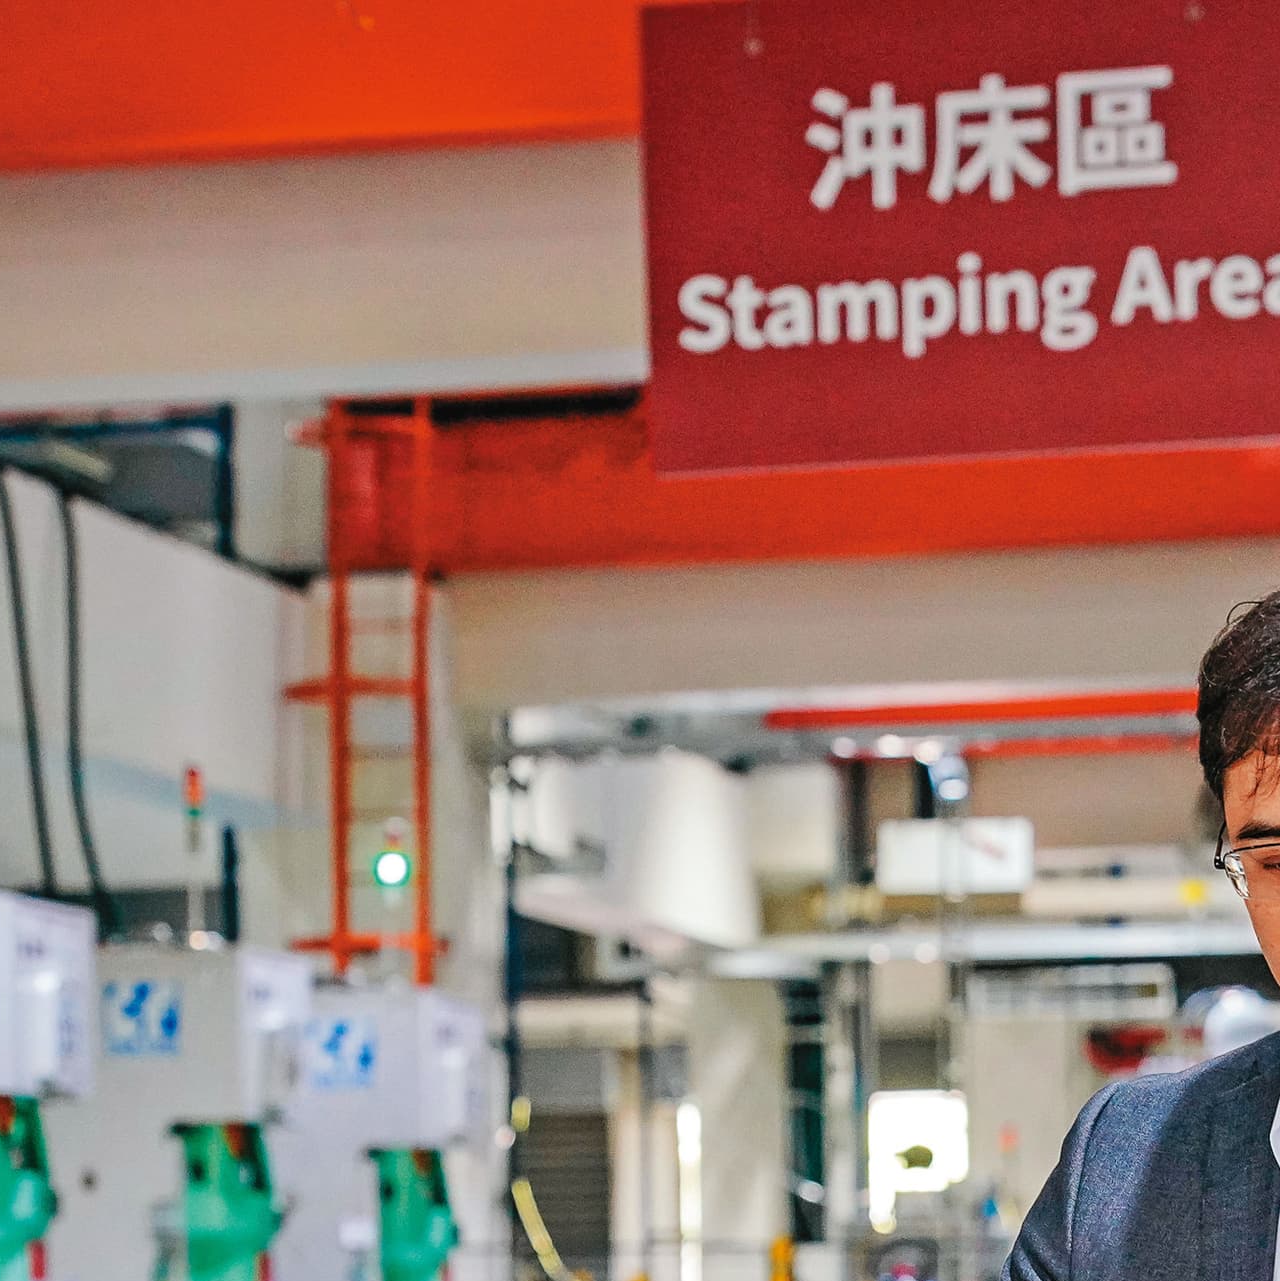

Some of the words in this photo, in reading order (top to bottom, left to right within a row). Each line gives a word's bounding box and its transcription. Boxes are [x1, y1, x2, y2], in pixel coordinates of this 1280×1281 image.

[805, 65, 1179, 210] 沖床區
[678, 251, 1099, 359] Stamping
